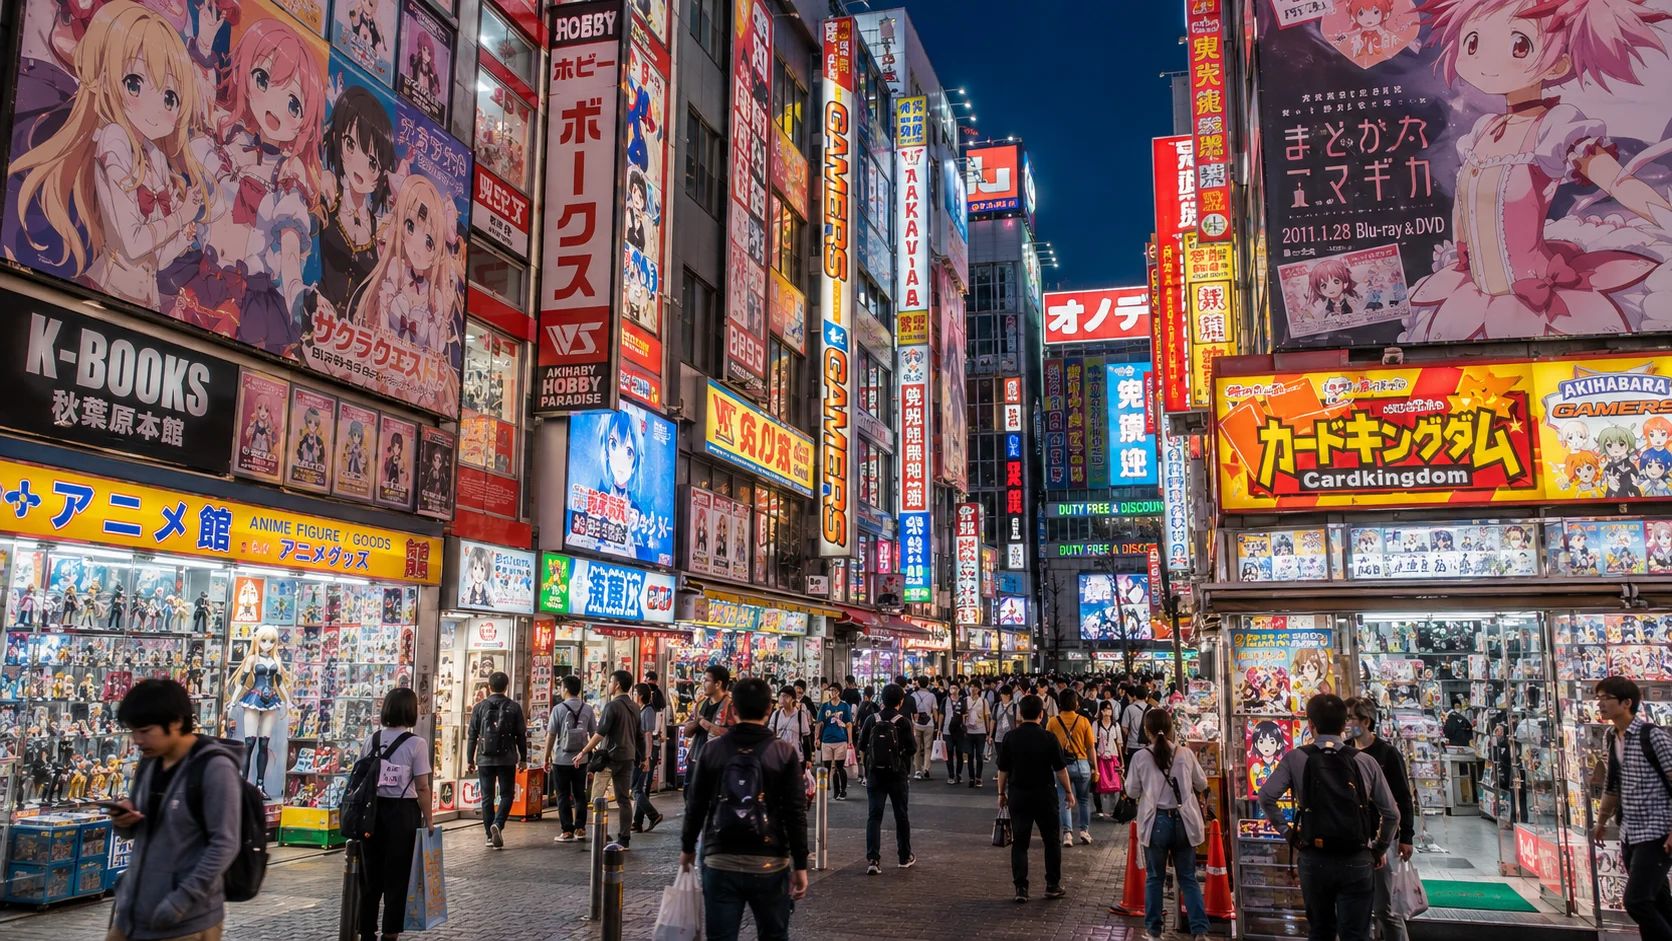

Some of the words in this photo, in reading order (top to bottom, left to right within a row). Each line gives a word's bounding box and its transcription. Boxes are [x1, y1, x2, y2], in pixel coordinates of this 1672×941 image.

[553, 53, 615, 81] ホビー
[554, 97, 602, 301] ボークス
[825, 101, 849, 283] GAMERS
[1282, 223, 1351, 244] 2011.1.28
[1356, 222, 1402, 239] Blu-ray
[1405, 222, 1414, 235] &
[1416, 216, 1445, 235] DVD
[26, 312, 210, 417] K-BOOKS
[547, 365, 596, 377] AKIHABY
[541, 393, 601, 408] PARADISE
[543, 376, 601, 395] HOBBY
[1564, 376, 1667, 399] AKIHABARA
[51, 389, 185, 447] 秋葉原本館
[823, 348, 847, 547] GAMERS
[1258, 406, 1523, 487] カードキングダム
[1303, 470, 1468, 488] Cardkingdom
[50, 482, 232, 551] アニメ館
[1059, 504, 1084, 515] DUTY
[1087, 503, 1110, 514] FREE
[250, 516, 292, 535] ANIME
[296, 523, 340, 542] FIGURE
[352, 533, 391, 550] GOODS
[279, 538, 370, 570] アニメグッズ
